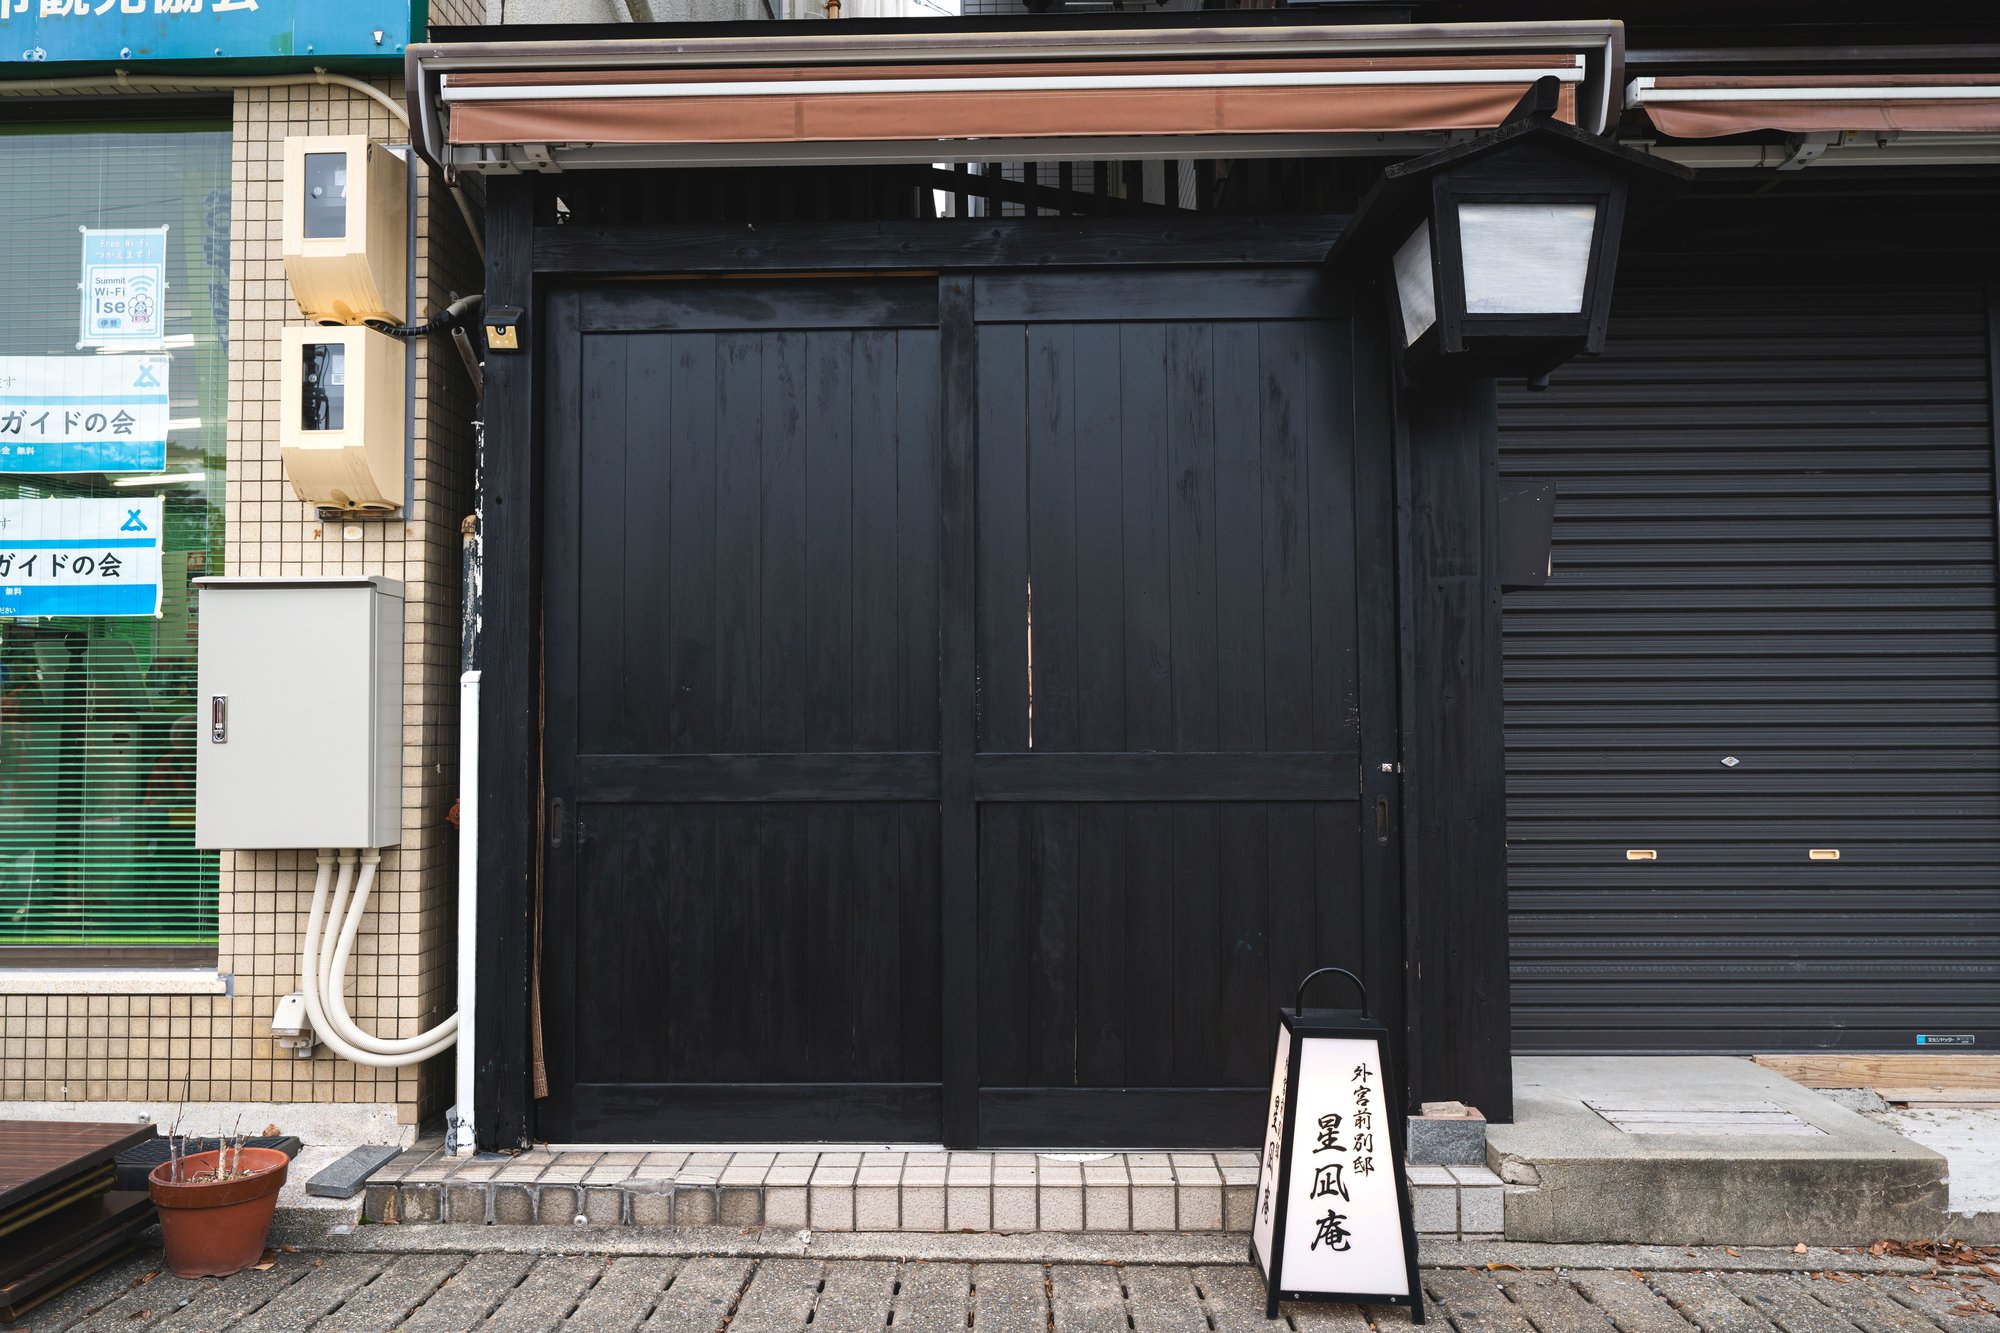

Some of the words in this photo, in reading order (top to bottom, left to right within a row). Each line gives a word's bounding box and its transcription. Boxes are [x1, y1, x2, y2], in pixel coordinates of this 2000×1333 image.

[100, 239, 120, 248] Free
[95, 277, 126, 285] Summit
[95, 287, 125, 297] Wi-Fi
[96, 298, 125, 314] Ise
[101, 319, 118, 328] 伊勢
[0, 409, 136, 435] ガイドの会
[0, 552, 122, 577] ガイドの会
[1351, 1062, 1375, 1178] 外宮前別邸
[1309, 1113, 1351, 1252] 星凪庵
